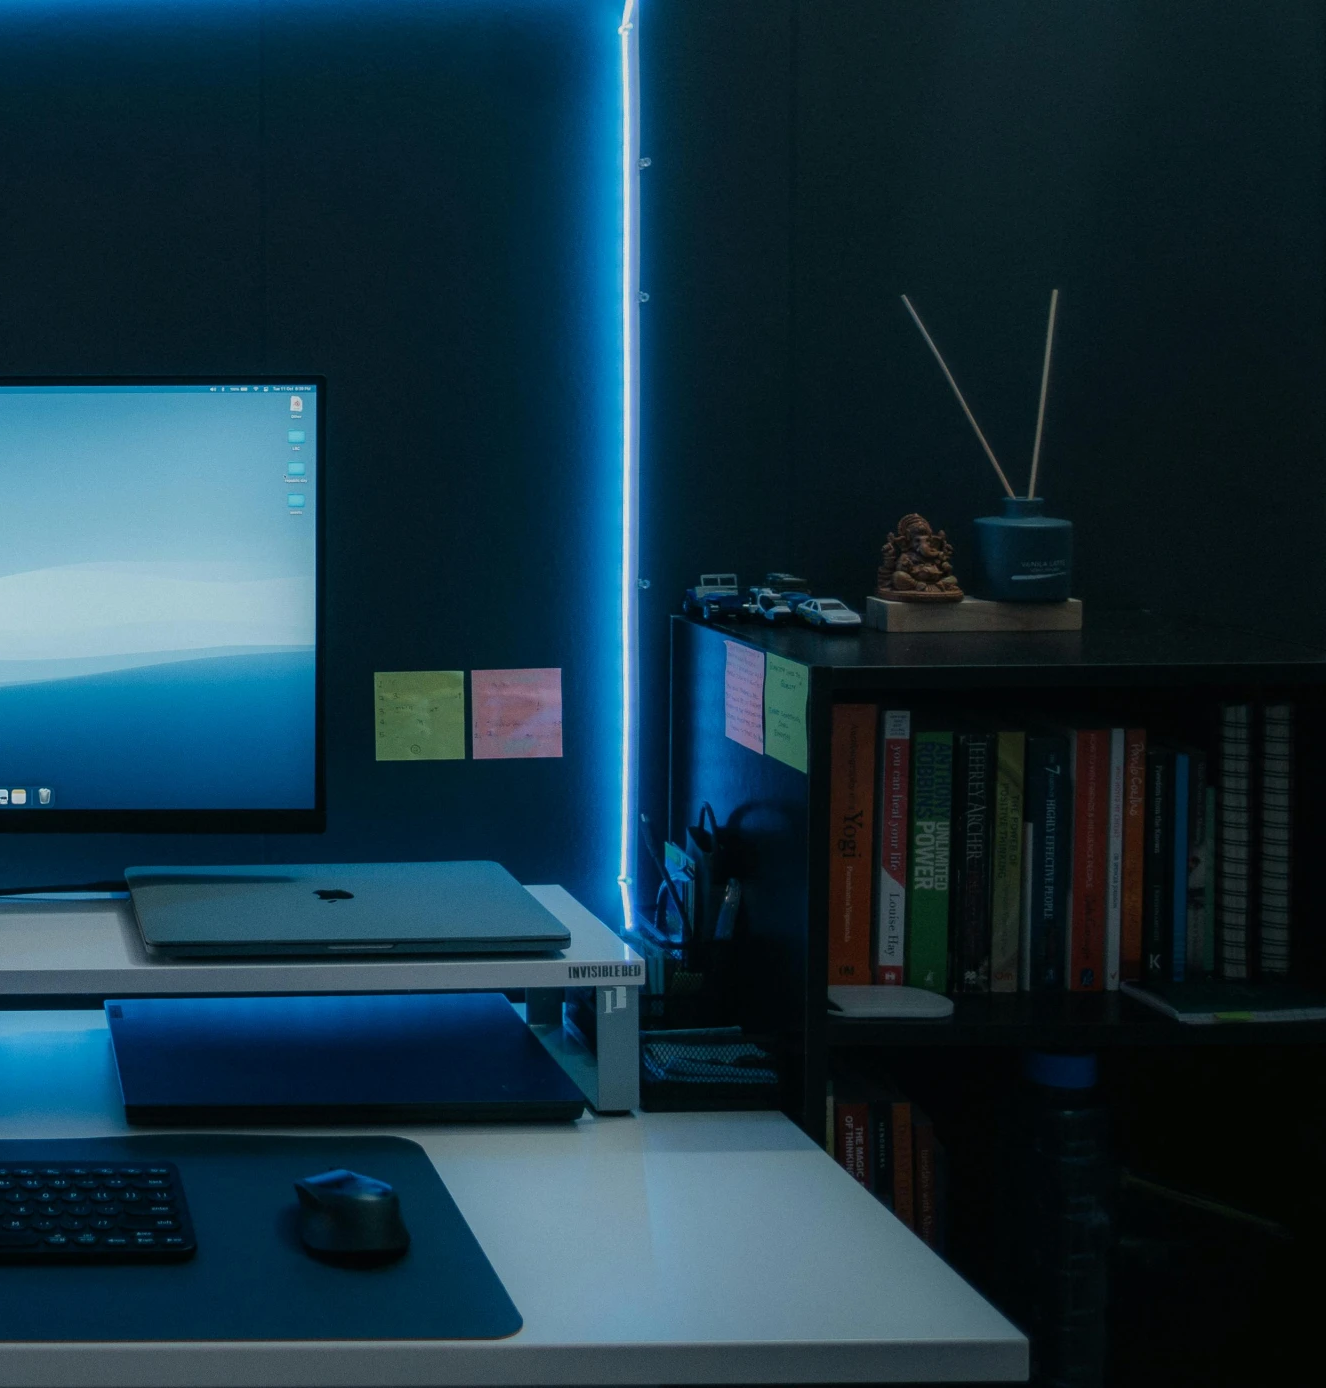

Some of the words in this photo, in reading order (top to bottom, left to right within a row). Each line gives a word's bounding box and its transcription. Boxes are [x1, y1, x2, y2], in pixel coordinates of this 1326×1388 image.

[890, 744, 902, 767] you
[966, 740, 987, 797] JEFFREY
[1045, 765, 1060, 775] 7
[1130, 743, 1144, 775] Paulo
[891, 771, 902, 790] can
[916, 742, 934, 819] ROBBINS
[934, 742, 952, 820] ANTHONY
[1129, 777, 1143, 816] Coelho
[891, 794, 904, 819] heal
[999, 783, 1009, 828] POSITIVE
[1010, 794, 1019, 813] THE
[1046, 799, 1056, 833] HIGHLY
[839, 811, 864, 858] Yogi
[889, 822, 901, 849] your
[965, 803, 987, 861] ARCHER
[1010, 816, 1019, 851] POWER
[1087, 819, 1095, 859] INFLUENCE
[889, 852, 901, 871] life
[914, 821, 935, 890] POWER
[934, 821, 950, 891] UNLIMITED
[997, 830, 1008, 879] THINKING
[1010, 854, 1019, 867] OF
[1044, 835, 1055, 884] EFFECTIVE
[1086, 860, 1094, 888] PEOPLE
[888, 893, 899, 932] Louise
[1044, 885, 1054, 920] PEOPLE
[885, 935, 898, 956] Hay
[1150, 953, 1160, 969] K
[845, 1115, 853, 1130] OF
[855, 1126, 864, 1144] THE
[855, 1146, 864, 1178] MAGIC
[920, 1149, 930, 1188] tuesdays
[922, 1192, 931, 1212] with
